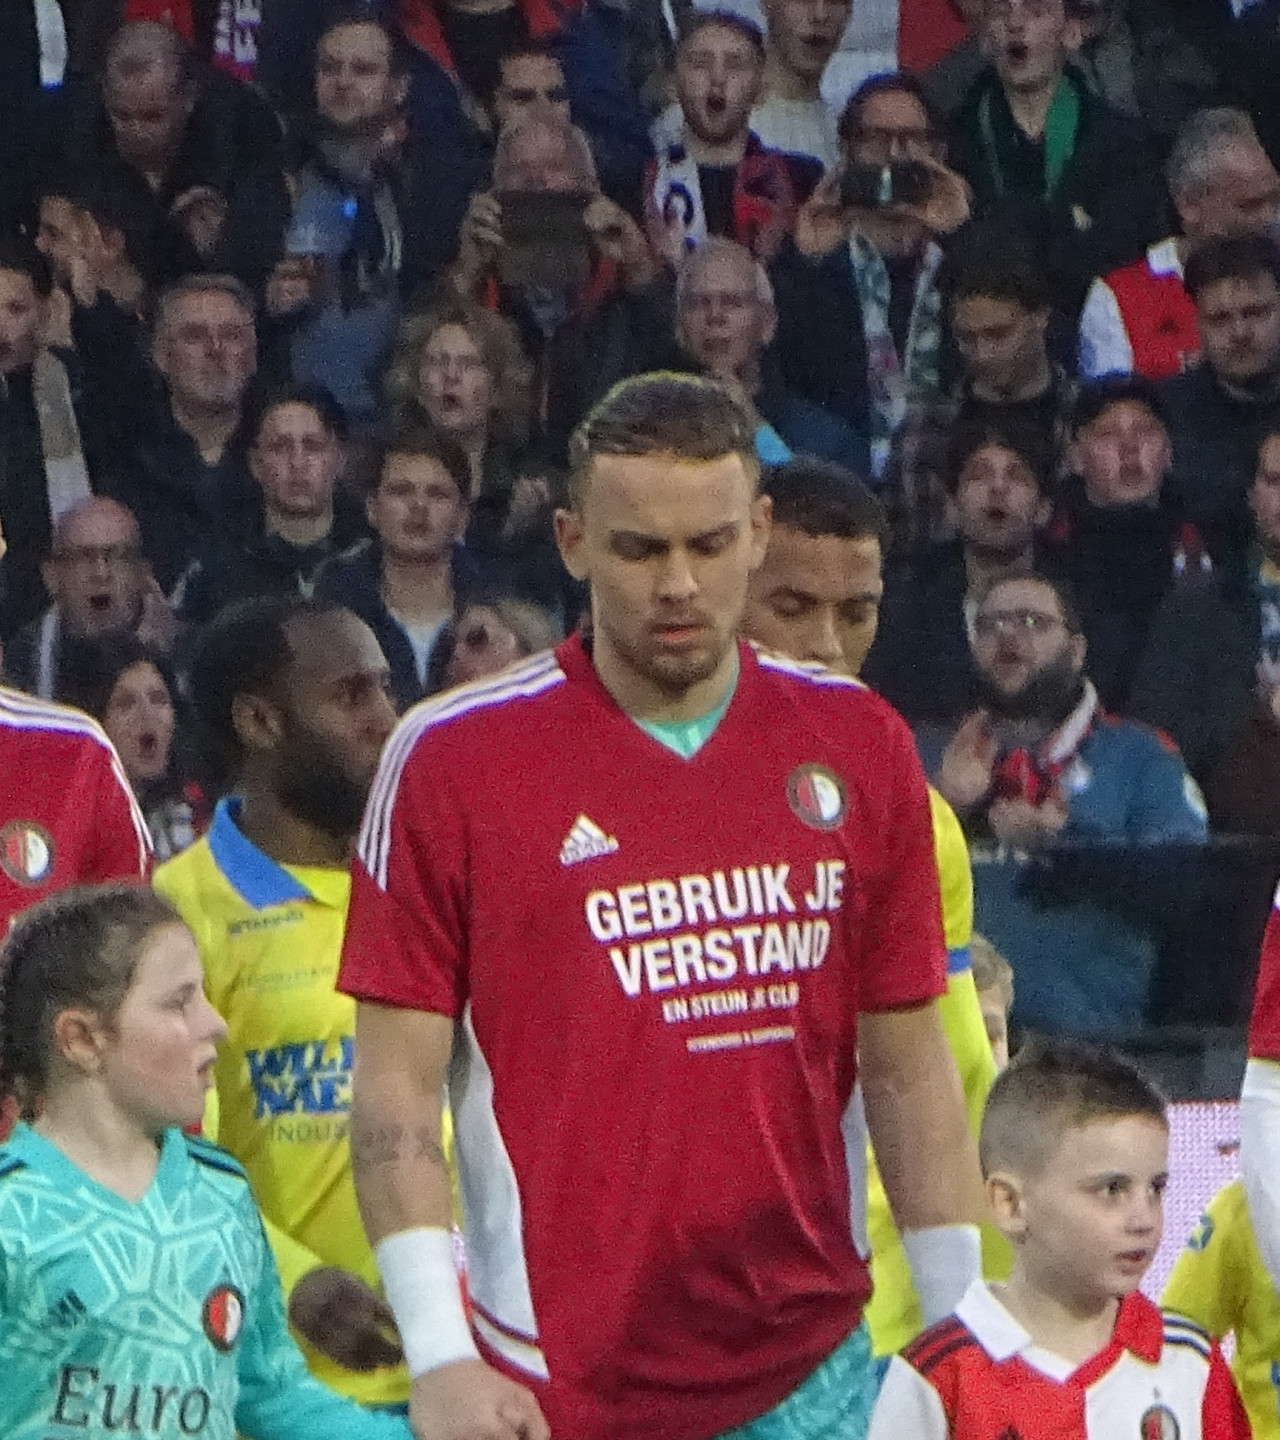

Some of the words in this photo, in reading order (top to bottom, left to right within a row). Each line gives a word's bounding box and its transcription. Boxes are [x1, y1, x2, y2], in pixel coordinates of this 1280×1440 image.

[584, 863, 797, 944] GEBRUIK
[804, 859, 847, 912] JE
[609, 917, 832, 998] VERSTAND
[53, 1363, 212, 1437] Euro
